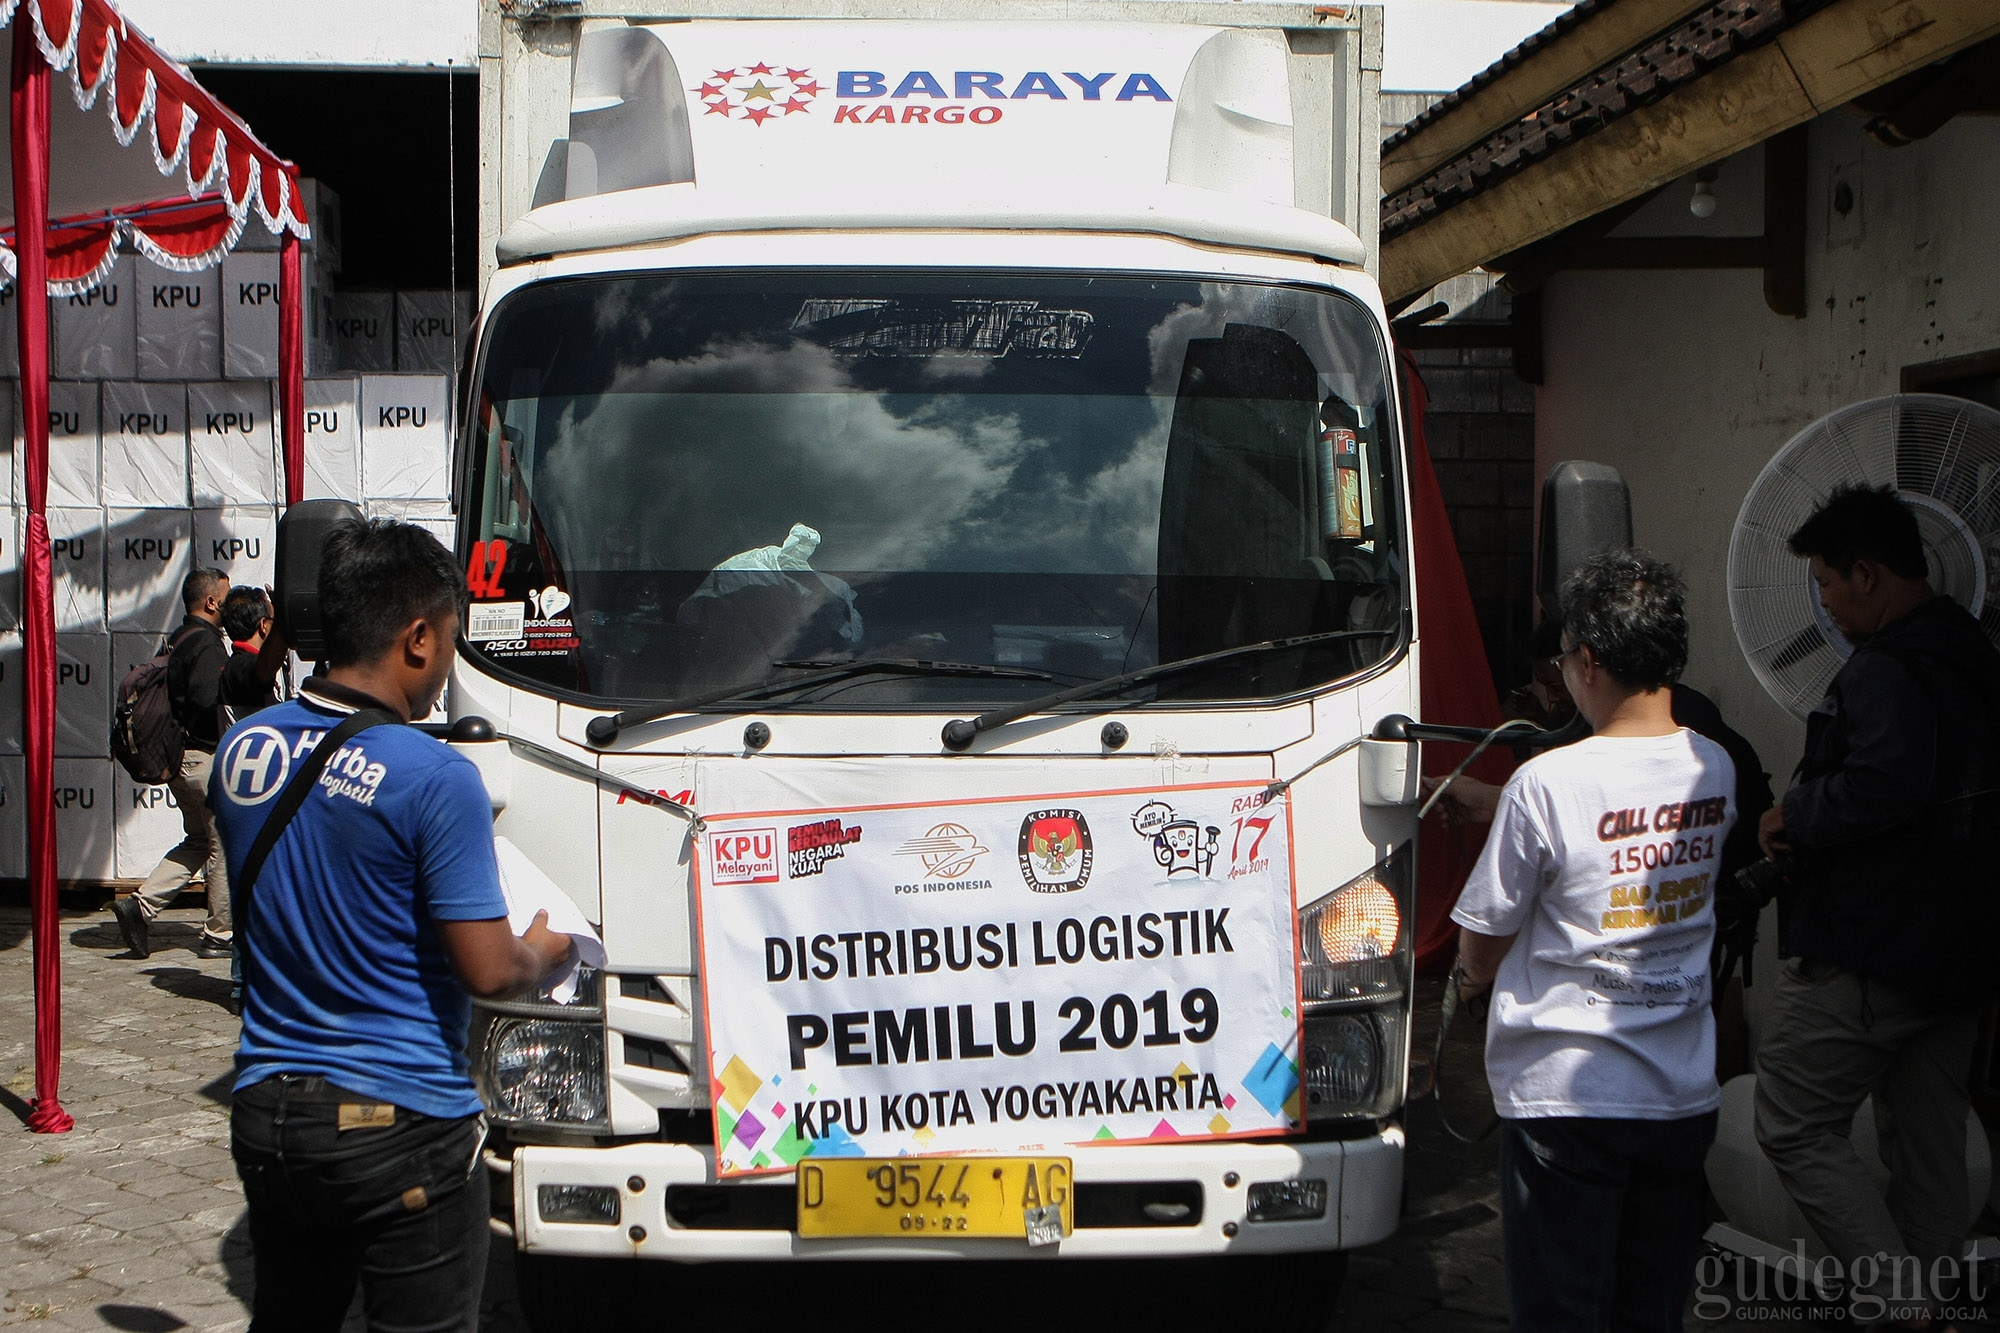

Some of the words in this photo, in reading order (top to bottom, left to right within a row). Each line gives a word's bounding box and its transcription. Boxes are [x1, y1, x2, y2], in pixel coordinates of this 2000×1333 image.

[834, 70, 1174, 102] BARAYA
[833, 105, 1003, 125] KARGO
[153, 285, 200, 307] KPU
[336, 318, 378, 338] KPU
[413, 318, 454, 337] KPU
[49, 412, 79, 434] PU
[120, 413, 168, 434] KPU
[207, 412, 254, 434] KPU
[304, 411, 338, 433] PU
[380, 405, 427, 428] KPU
[54, 538, 84, 560] PU
[125, 538, 172, 560] KPU
[213, 537, 260, 560] KPU
[467, 539, 508, 598] 42
[524, 619, 573, 628] INDONESIA
[484, 640, 528, 651] ASCO
[530, 638, 580, 649] ISUZU
[57, 664, 90, 685] PU
[292, 729, 387, 791] Hrba
[319, 765, 377, 807] logistik
[133, 787, 179, 809] KPU
[1028, 809, 1081, 824] KOMISI
[1144, 811, 1157, 821] AYO
[1597, 807, 1649, 842] CALL
[1653, 796, 1727, 833] CENTER
[789, 820, 840, 837] PEMILIH
[789, 828, 861, 850] BERDAULAT
[1230, 813, 1277, 864] 17
[715, 835, 772, 862] KPU
[789, 843, 843, 863] NEGARA
[1609, 834, 1715, 875] 1500261
[717, 859, 773, 876] Melayani
[789, 860, 823, 876] KUAT
[1019, 854, 1068, 894] PEMILIHAN
[1077, 848, 1093, 888] UMUM
[1227, 865, 1248, 880] April
[1248, 859, 1268, 875] 2019
[895, 885, 922, 895] POS
[924, 879, 992, 894] INDONESIA
[1610, 884, 1652, 908] SIAP
[764, 922, 1018, 982] DISTRIBUSI
[1032, 907, 1235, 966] LOGISTIK
[786, 1000, 1038, 1071] PEMILU
[1057, 987, 1219, 1053] 2019
[793, 1096, 869, 1140] KPU
[881, 1089, 976, 1134] KOTA
[980, 1072, 1223, 1125] YOGYAKARTA
[804, 1165, 824, 1208] D
[876, 1163, 970, 1208] 9544
[1022, 1163, 1068, 1208] AG
